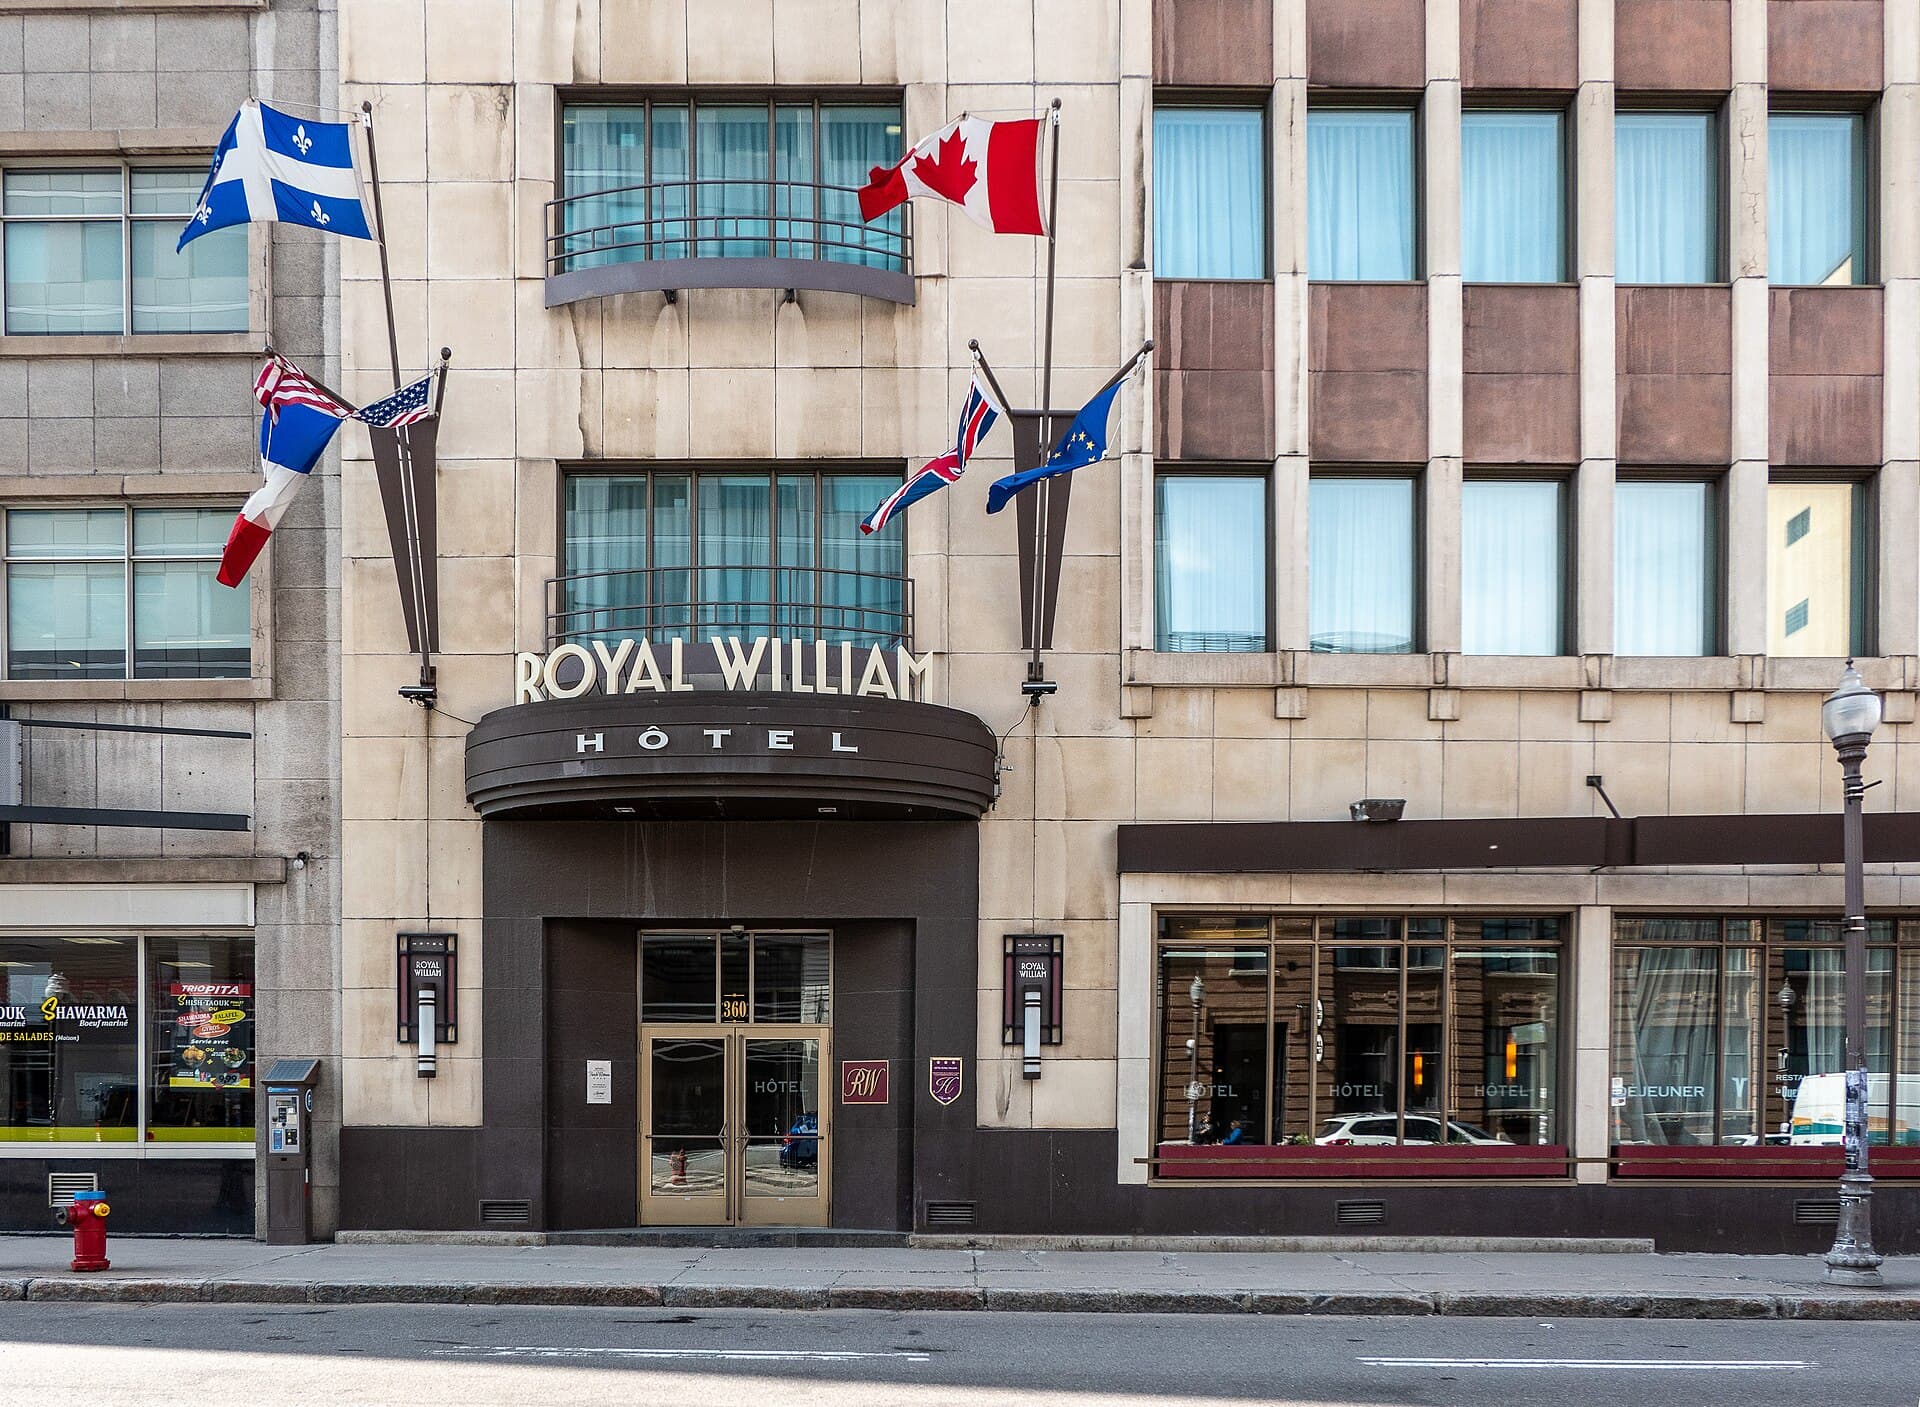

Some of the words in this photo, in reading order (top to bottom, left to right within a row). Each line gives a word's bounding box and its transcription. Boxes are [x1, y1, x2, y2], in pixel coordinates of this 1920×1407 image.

[516, 636, 694, 705] ROYAL
[710, 636, 934, 705] WILLIAM
[576, 725, 859, 754] HÔTEL
[415, 961, 440, 969] ROYAL
[1021, 962, 1045, 970] ROYAL
[414, 969, 442, 977] WILLIAM
[1019, 970, 1047, 978] WILLIAM
[41, 996, 128, 1021] SHAWARMA
[723, 1000, 747, 1018] 360
[79, 1020, 101, 1028] Boeuf
[101, 1019, 129, 1027] mariné
[0, 1032, 12, 1041] DE
[14, 1032, 54, 1041] SALADES
[754, 1078, 808, 1093] HÔTEL
[1329, 1082, 1384, 1097] HÔTEL
[1474, 1082, 1529, 1097] HÔTEL
